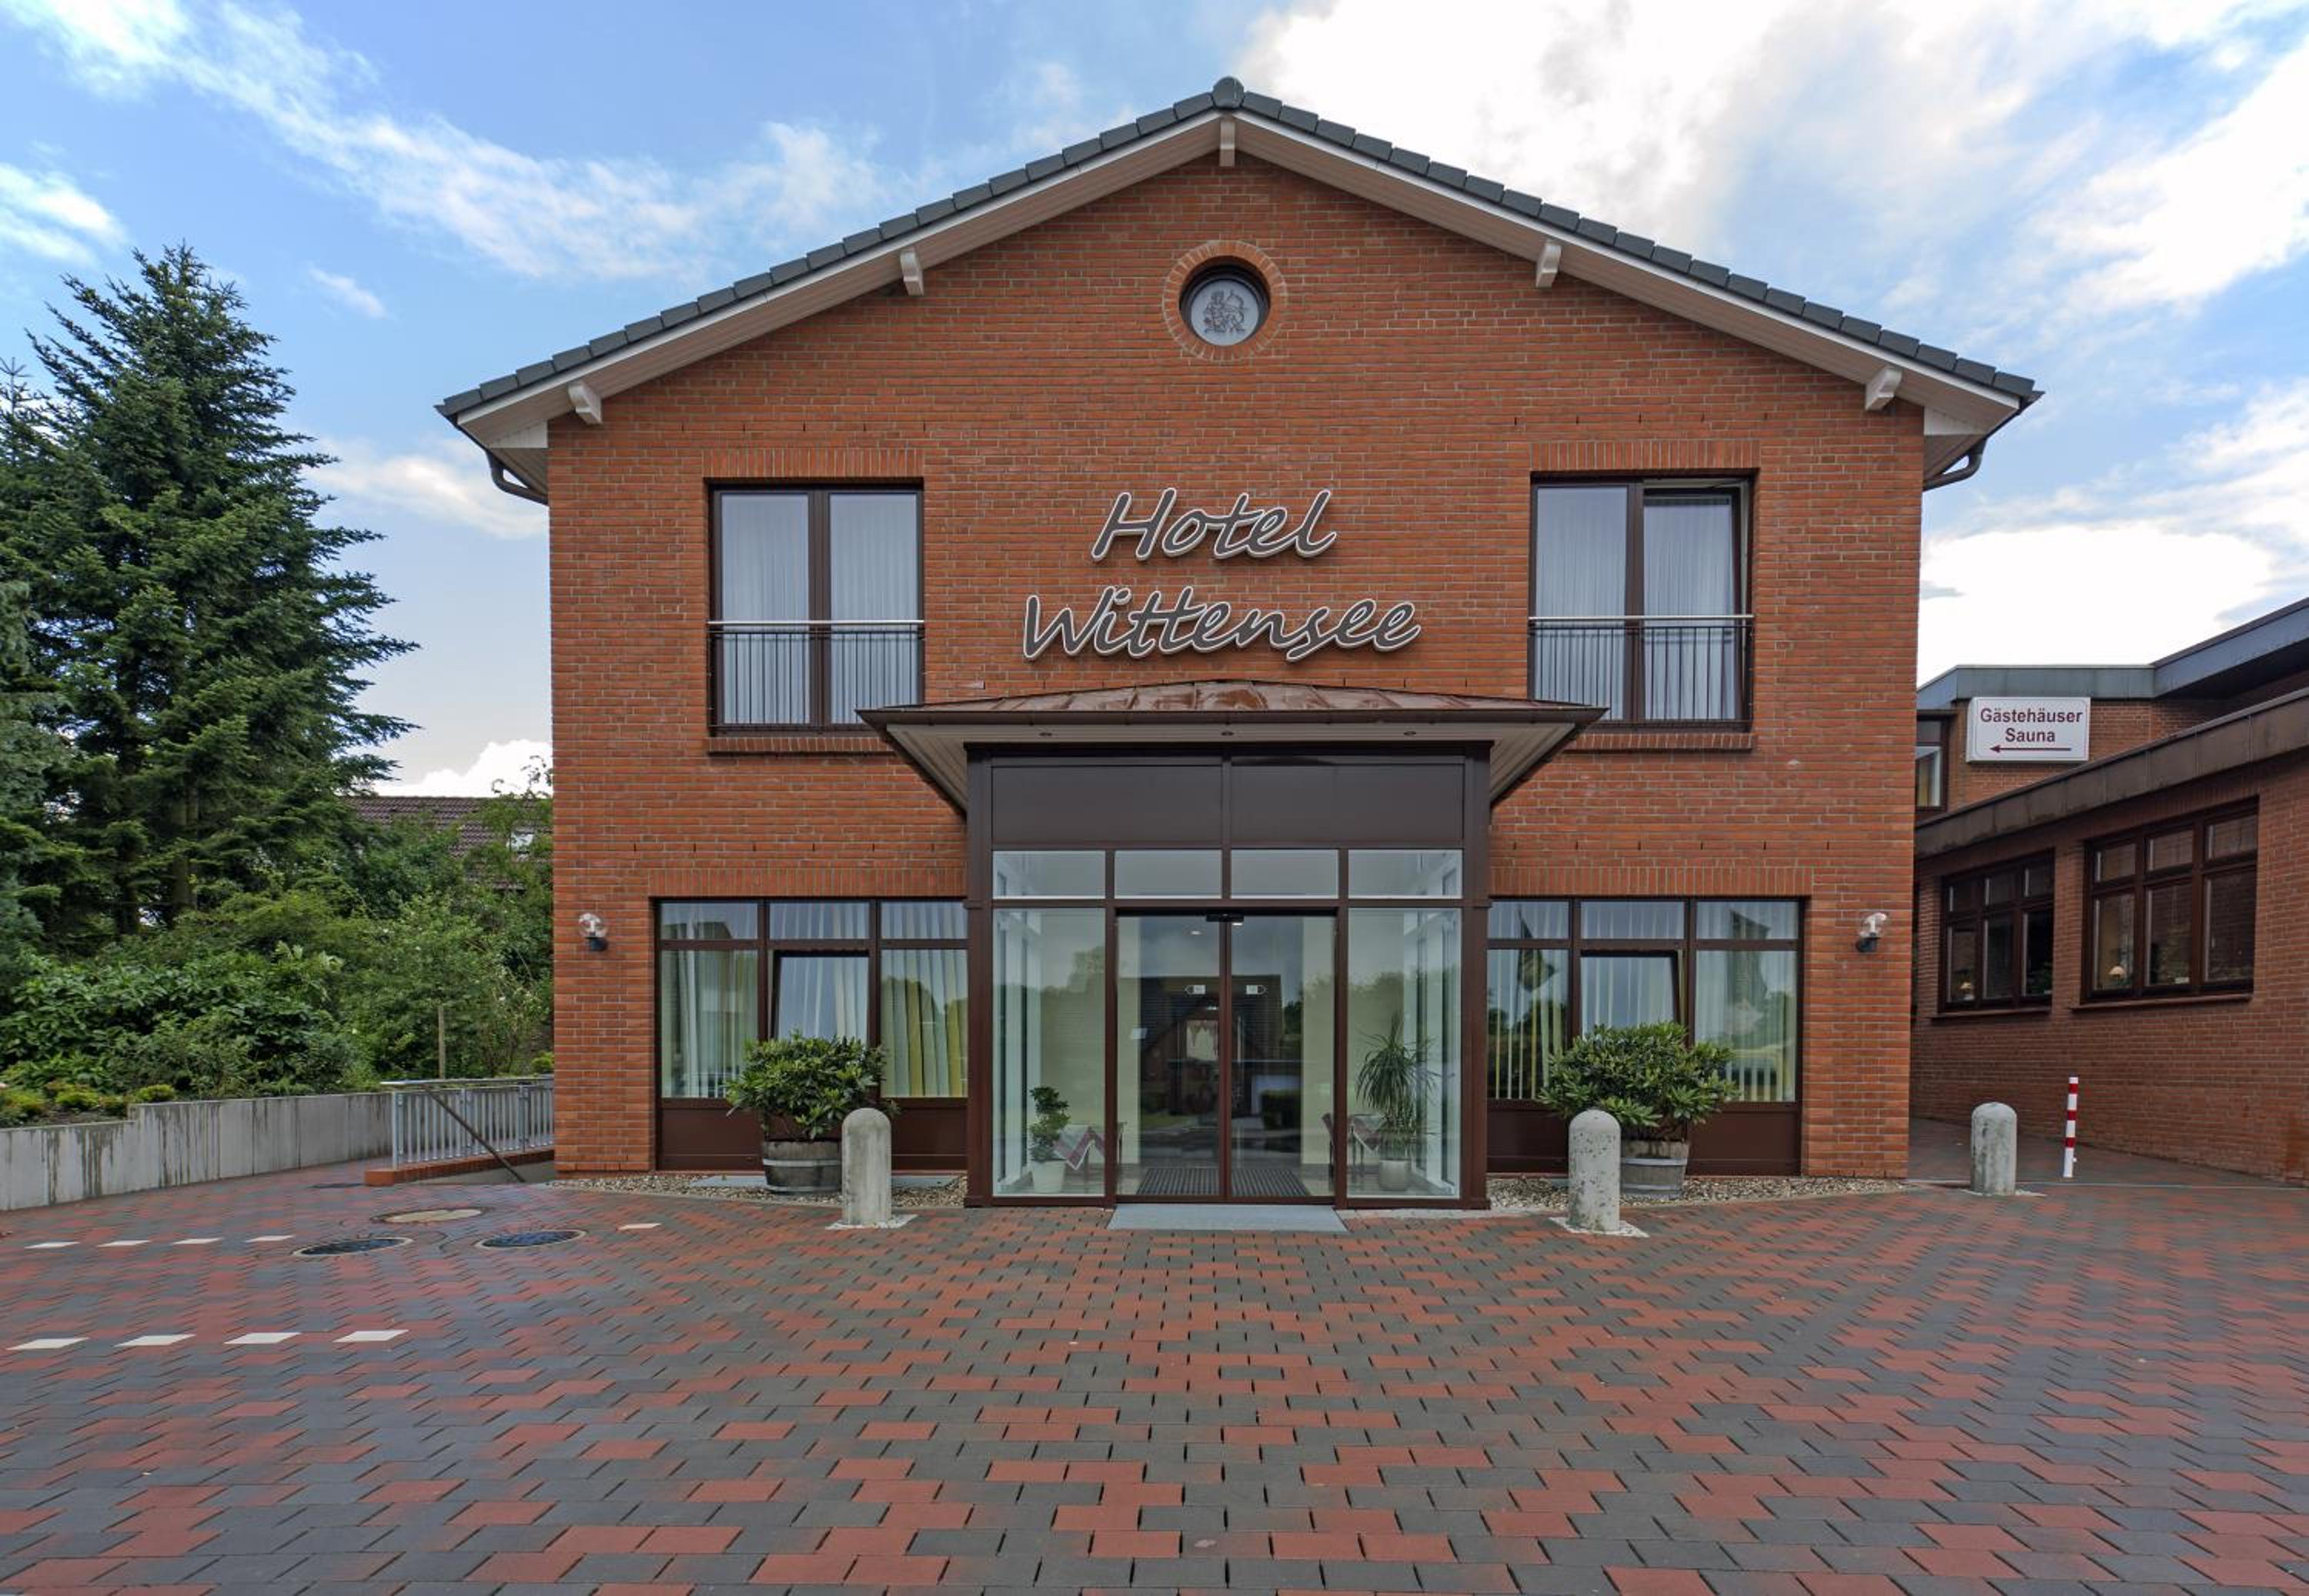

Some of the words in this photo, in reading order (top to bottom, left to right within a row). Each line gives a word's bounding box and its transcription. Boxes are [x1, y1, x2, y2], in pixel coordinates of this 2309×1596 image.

[1091, 487, 1337, 561] Hotel
[1023, 586, 1422, 662] Wittensee
[1980, 707, 2083, 723] Gästehäuser
[2005, 727, 2056, 743] Sauna
